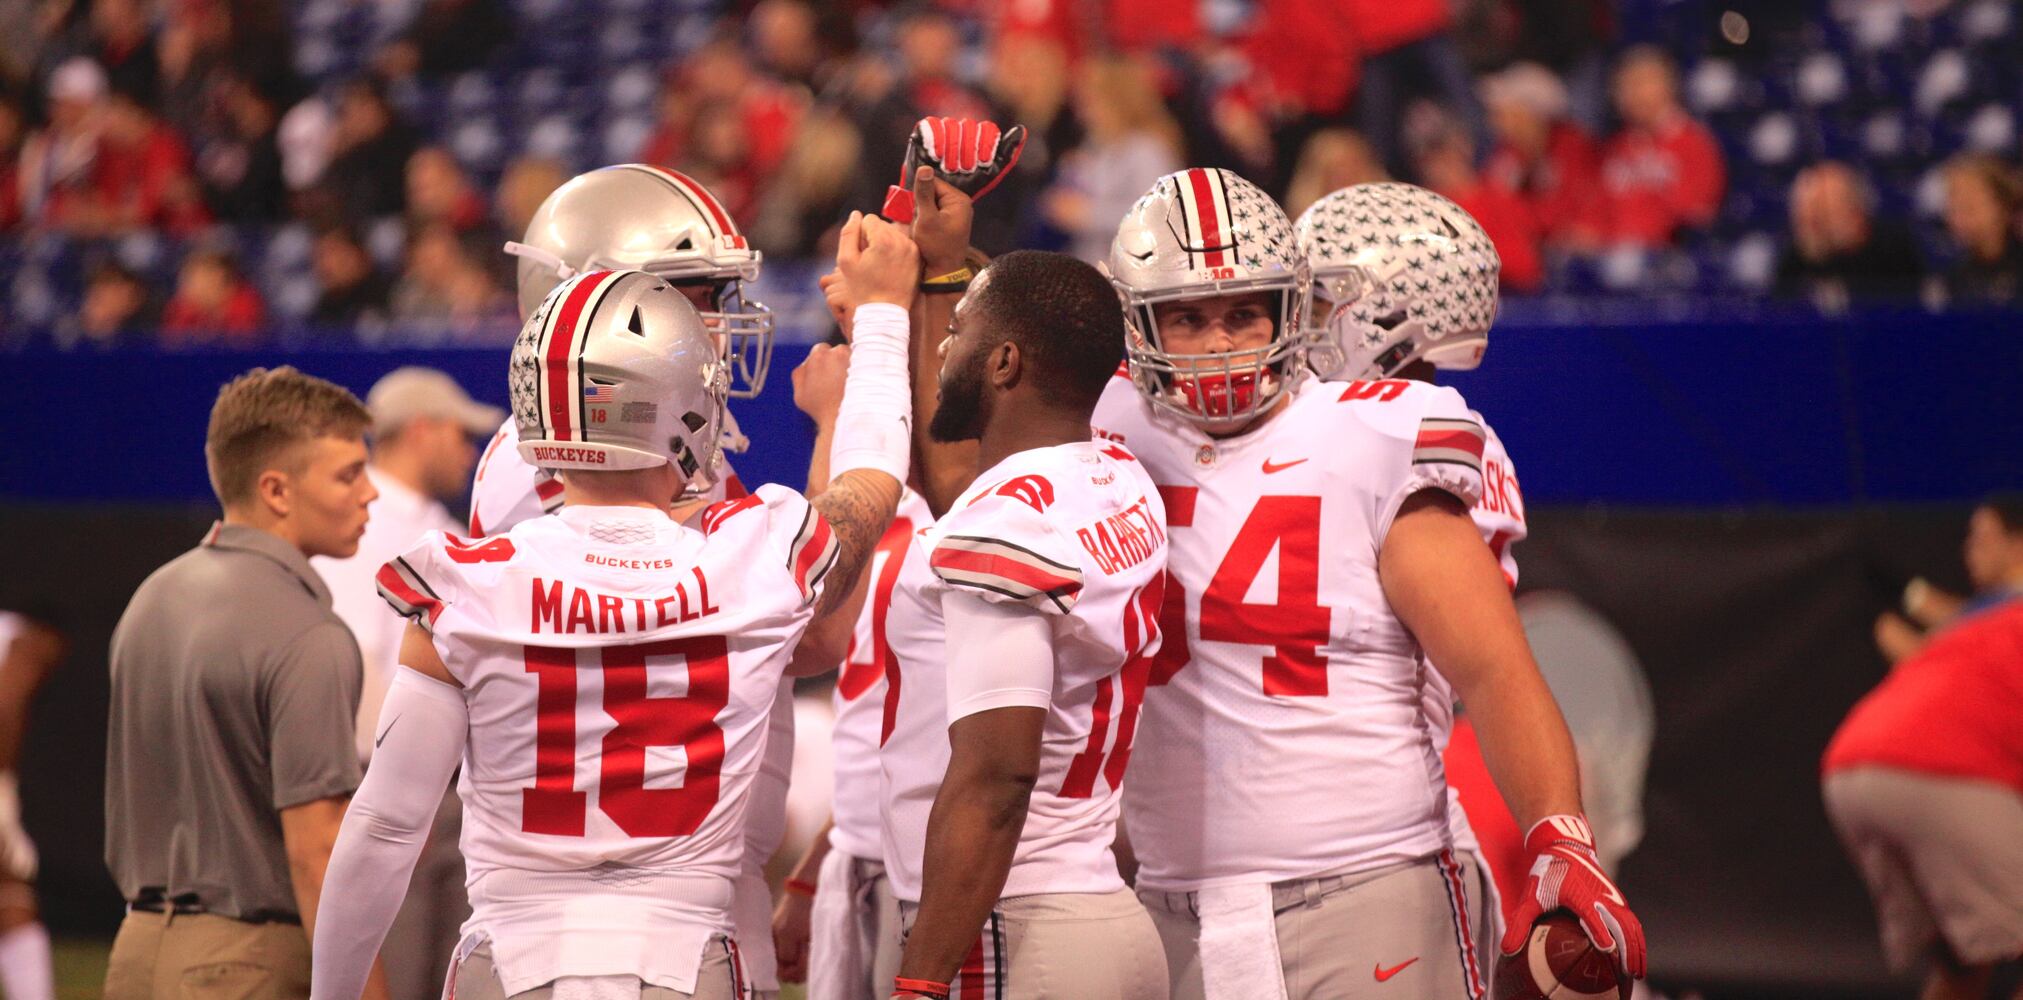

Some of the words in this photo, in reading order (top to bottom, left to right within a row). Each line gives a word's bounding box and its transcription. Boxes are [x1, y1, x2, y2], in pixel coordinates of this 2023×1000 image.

[591, 408, 607, 424] 18
[534, 446, 606, 464] BUCKEYES
[585, 553, 674, 570] BUCKEYES
[532, 566, 720, 634] MARTELL
[522, 634, 730, 838] 18
